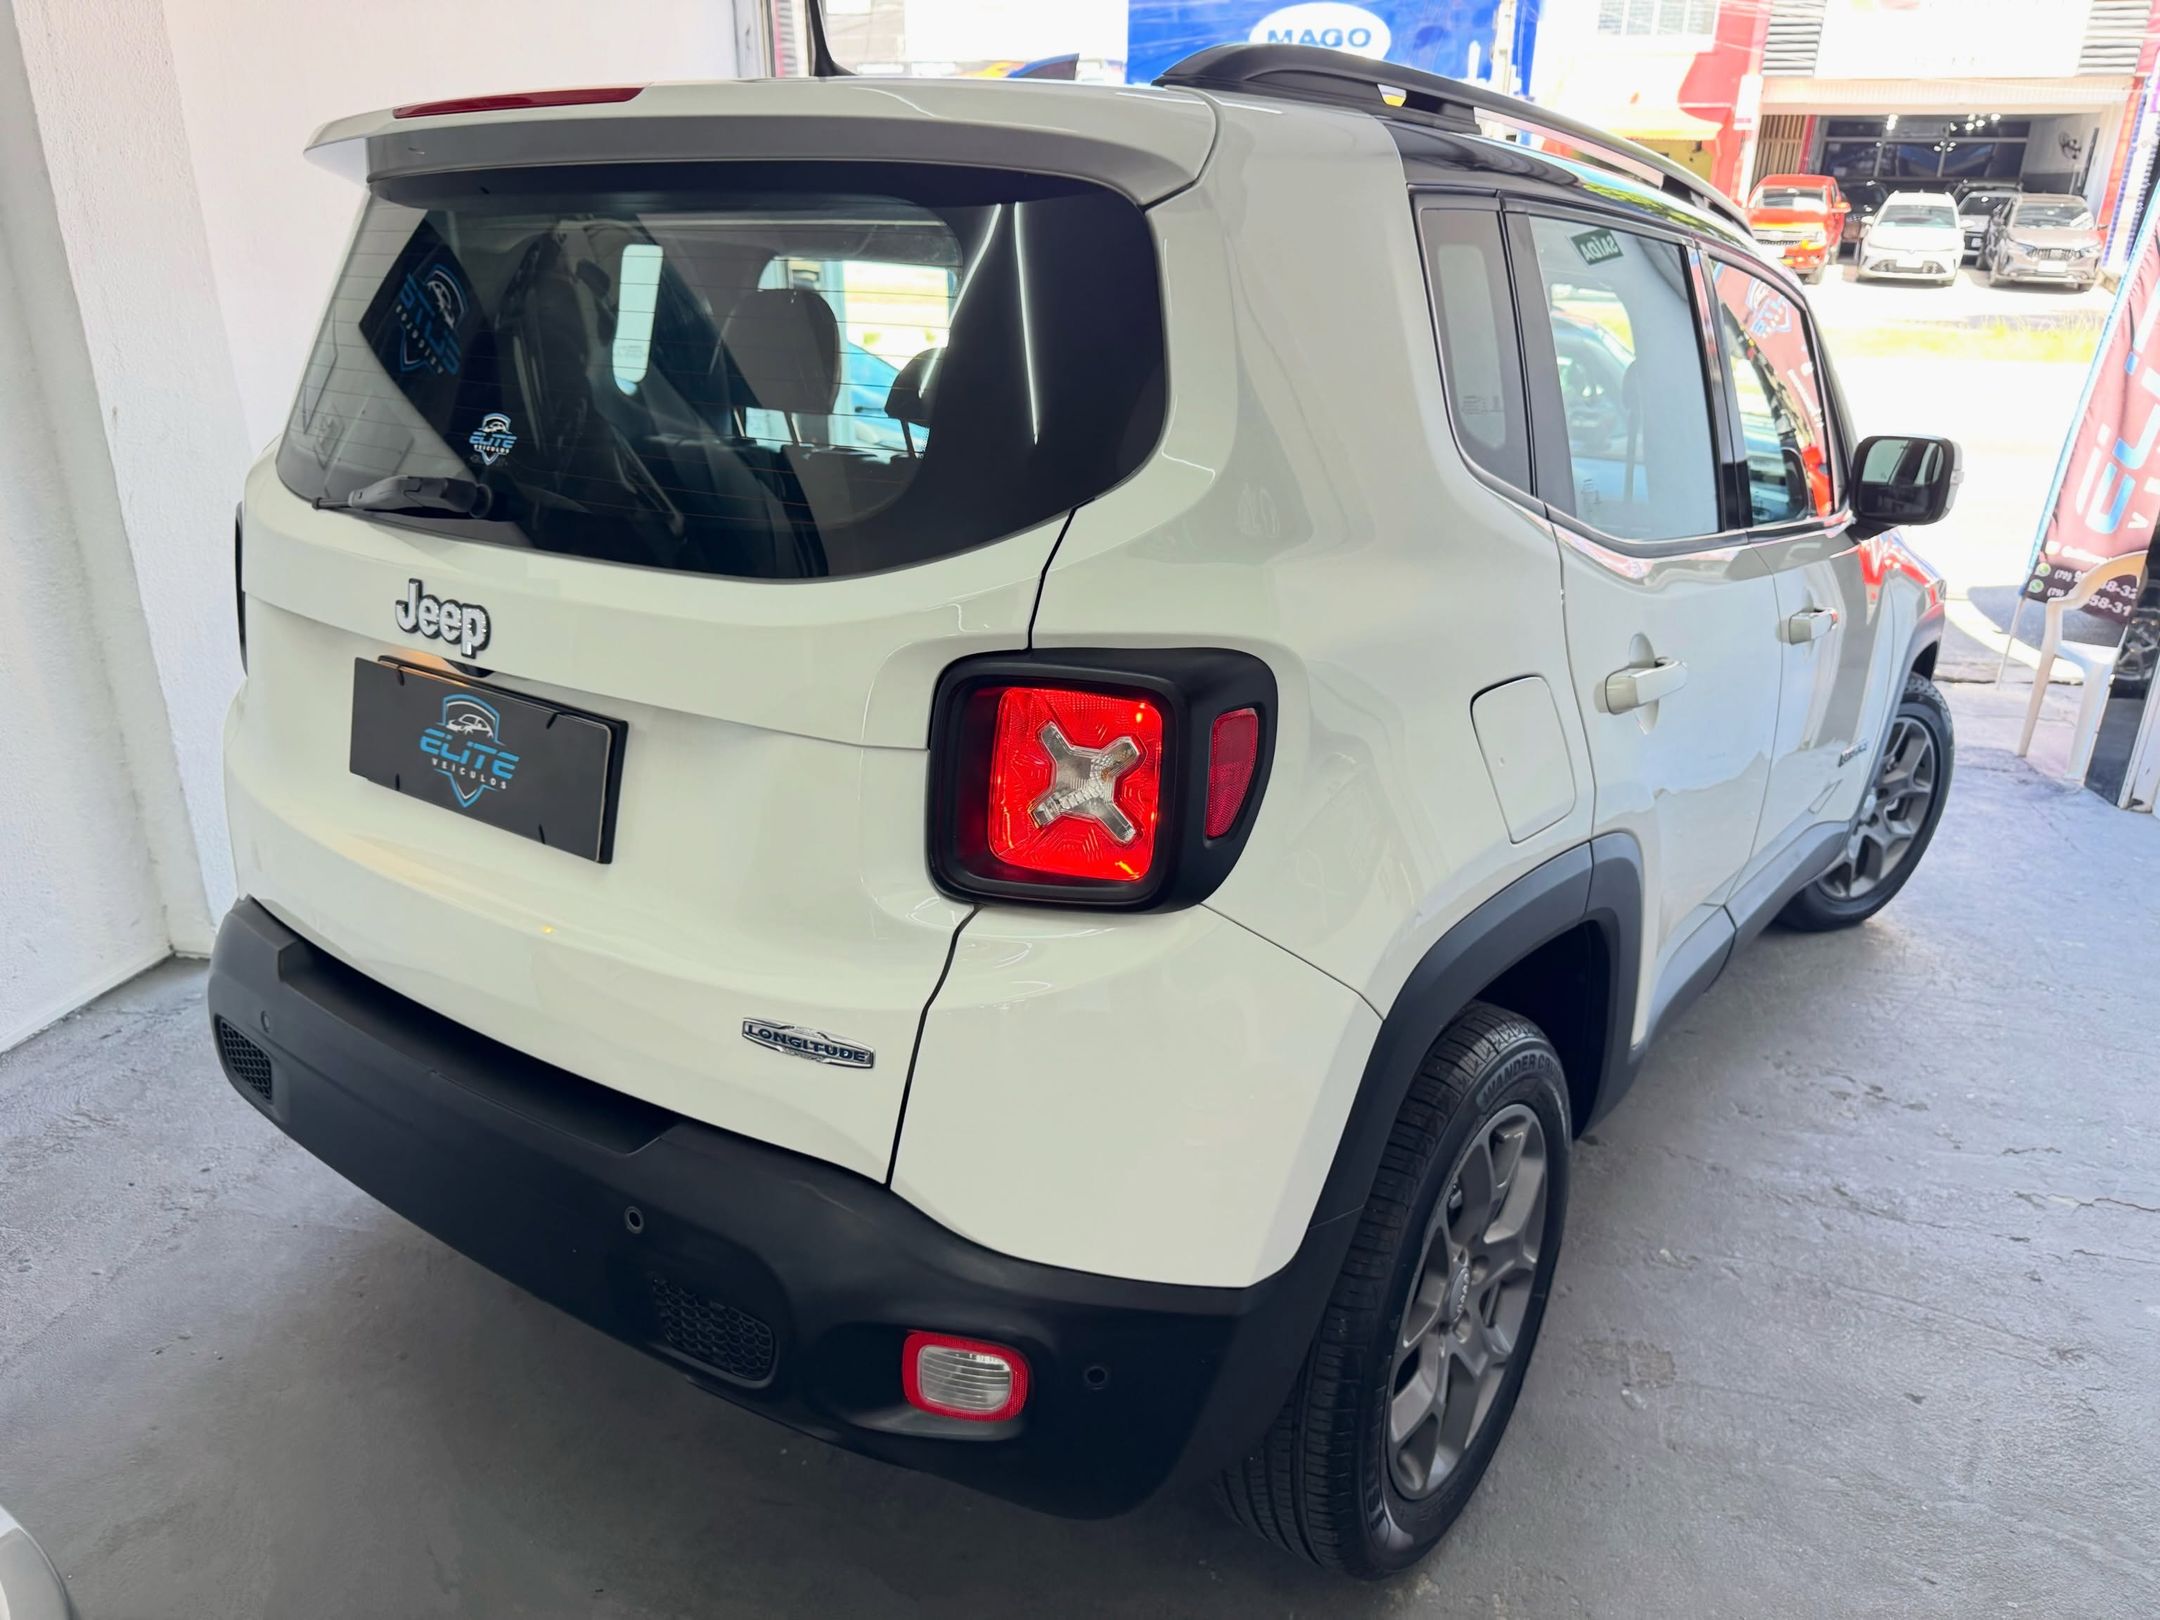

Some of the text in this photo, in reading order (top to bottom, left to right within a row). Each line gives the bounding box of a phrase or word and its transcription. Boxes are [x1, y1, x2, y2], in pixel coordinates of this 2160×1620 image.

[469, 431, 517, 449] ELITE
[395, 578, 491, 659] Jeep
[419, 727, 520, 781] ELITE
[431, 757, 507, 790] VEICULOS
[746, 1024, 869, 1063] LONGITUDE
